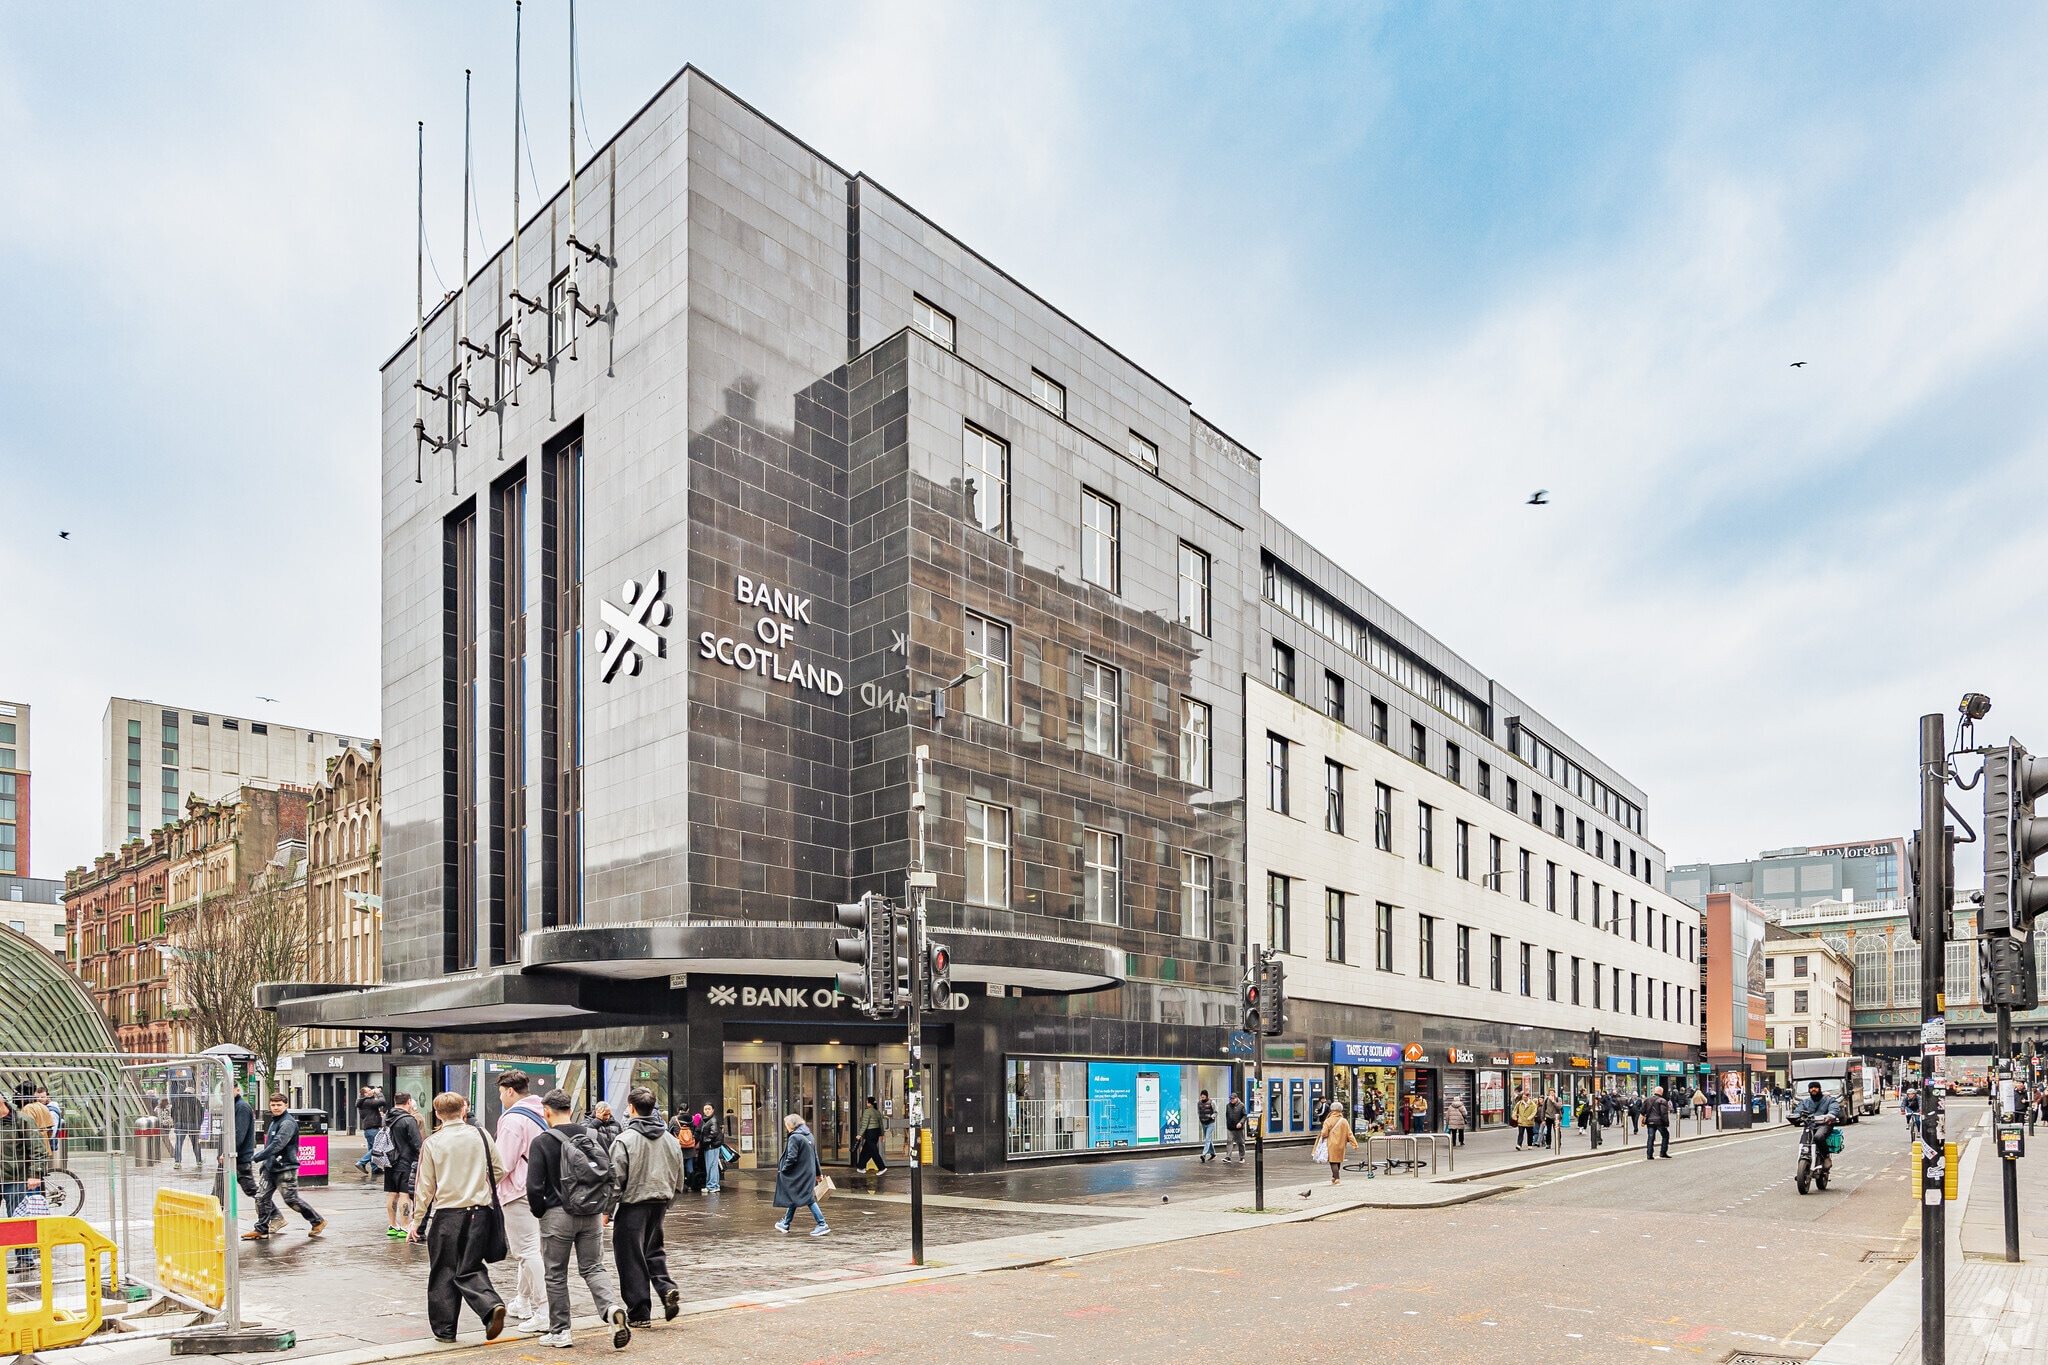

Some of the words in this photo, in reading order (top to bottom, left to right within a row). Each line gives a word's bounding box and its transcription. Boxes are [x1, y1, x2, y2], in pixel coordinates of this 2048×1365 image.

[737, 574, 811, 625] BANK
[757, 616, 794, 649] OF
[700, 631, 844, 697] SCOTLAND
[742, 986, 808, 1008] BANK
[812, 988, 845, 1008] OF
[1346, 1044, 1361, 1056] TASTE
[1362, 1045, 1369, 1056] OF
[1369, 1045, 1393, 1057] SCOTLAND
[1456, 1049, 1474, 1063] Blacks
